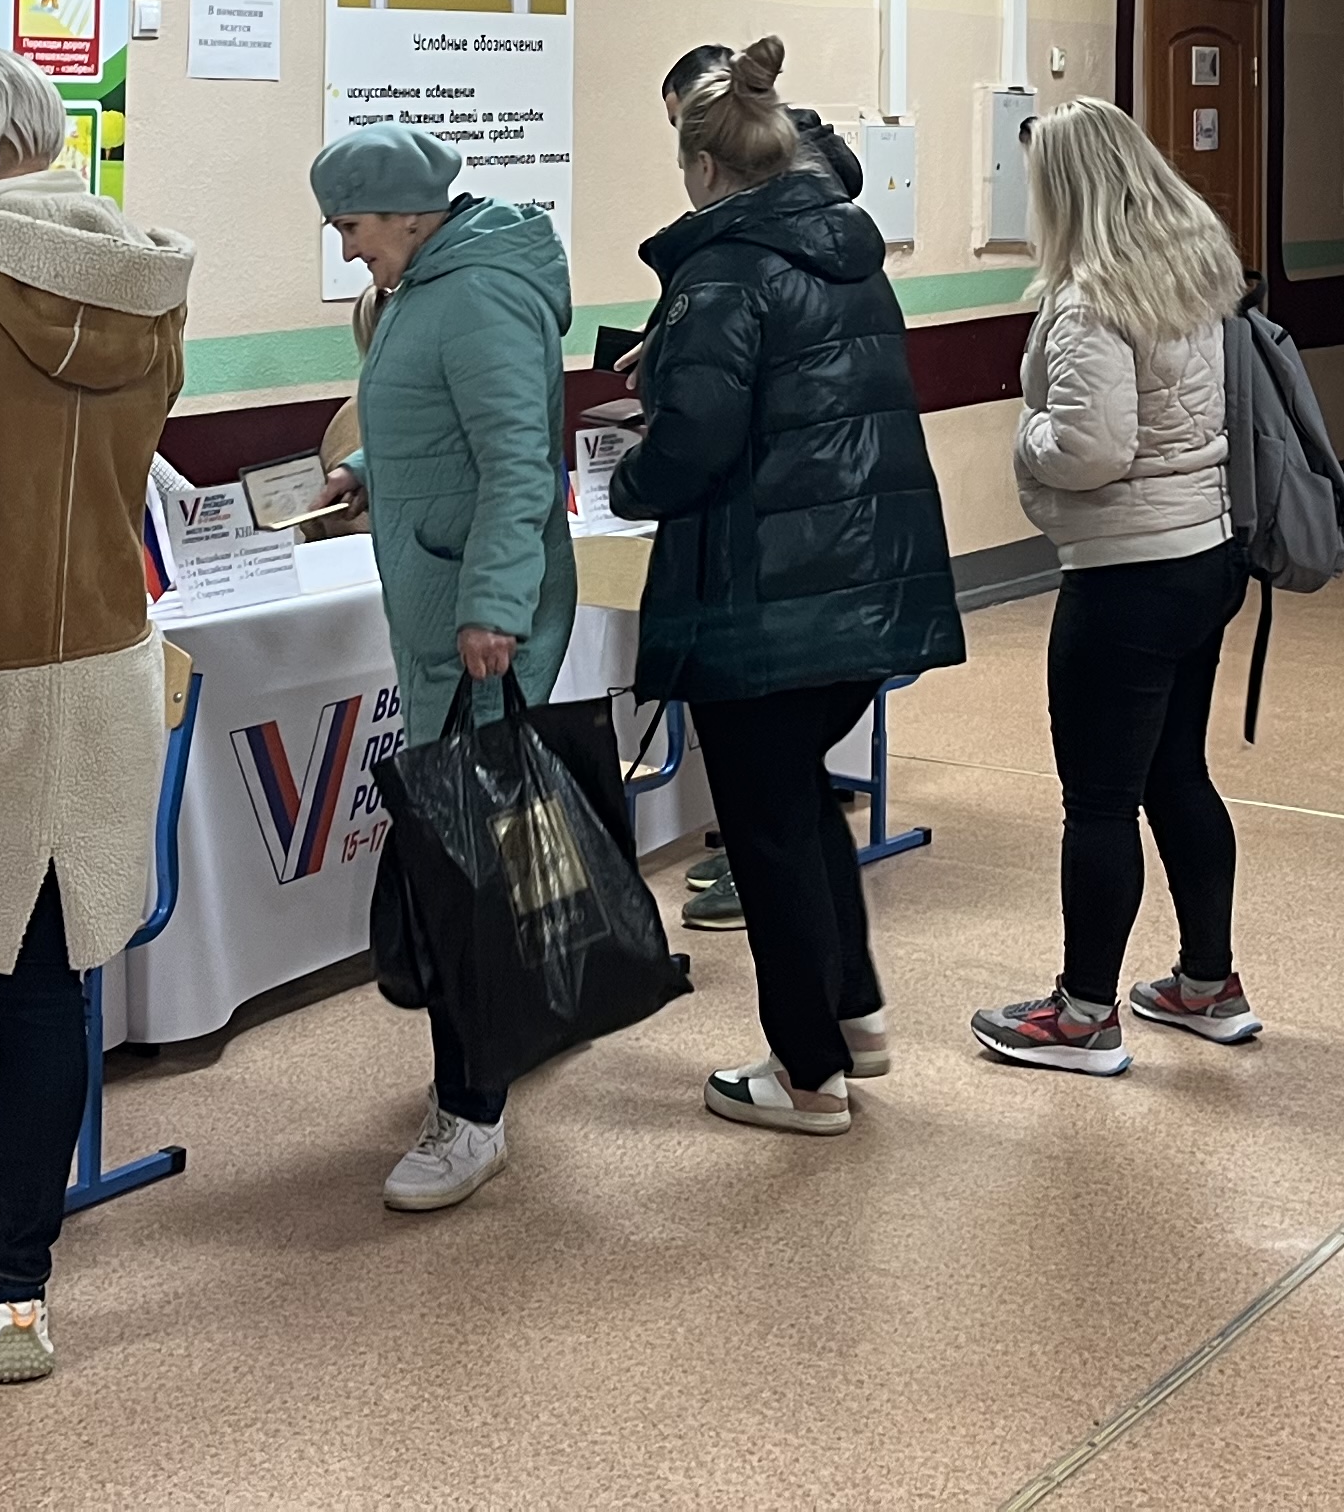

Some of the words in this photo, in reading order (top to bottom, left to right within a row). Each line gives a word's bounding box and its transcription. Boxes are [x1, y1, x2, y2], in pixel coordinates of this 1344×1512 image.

[413, 33, 468, 51] Условные
[473, 35, 543, 52] обозначения
[347, 84, 420, 102] искусственное
[426, 84, 475, 99] освещение
[399, 110, 444, 124] движения
[449, 108, 477, 123] детей
[482, 112, 493, 122] от
[498, 108, 544, 122] остановок
[488, 125, 524, 143] средств
[466, 153, 535, 168] транспортного
[539, 152, 570, 163] потока
